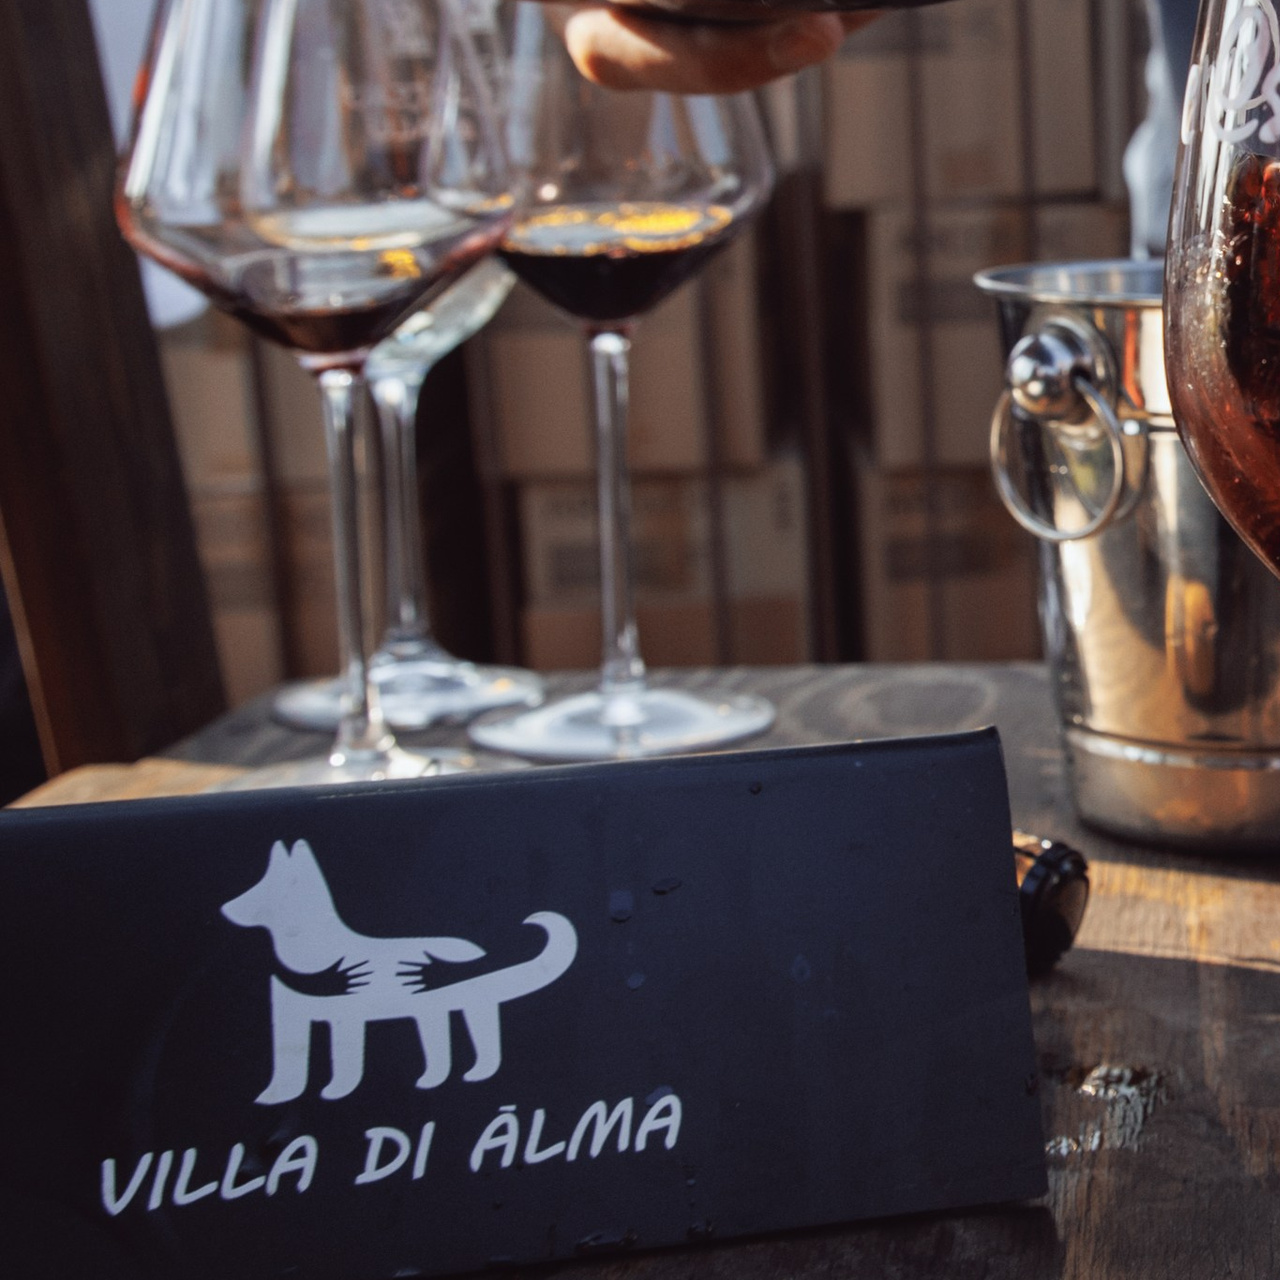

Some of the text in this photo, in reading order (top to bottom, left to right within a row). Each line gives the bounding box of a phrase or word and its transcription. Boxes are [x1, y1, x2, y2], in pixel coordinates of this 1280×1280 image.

[101, 1092, 683, 1217] VILLA DI ĀLMA
